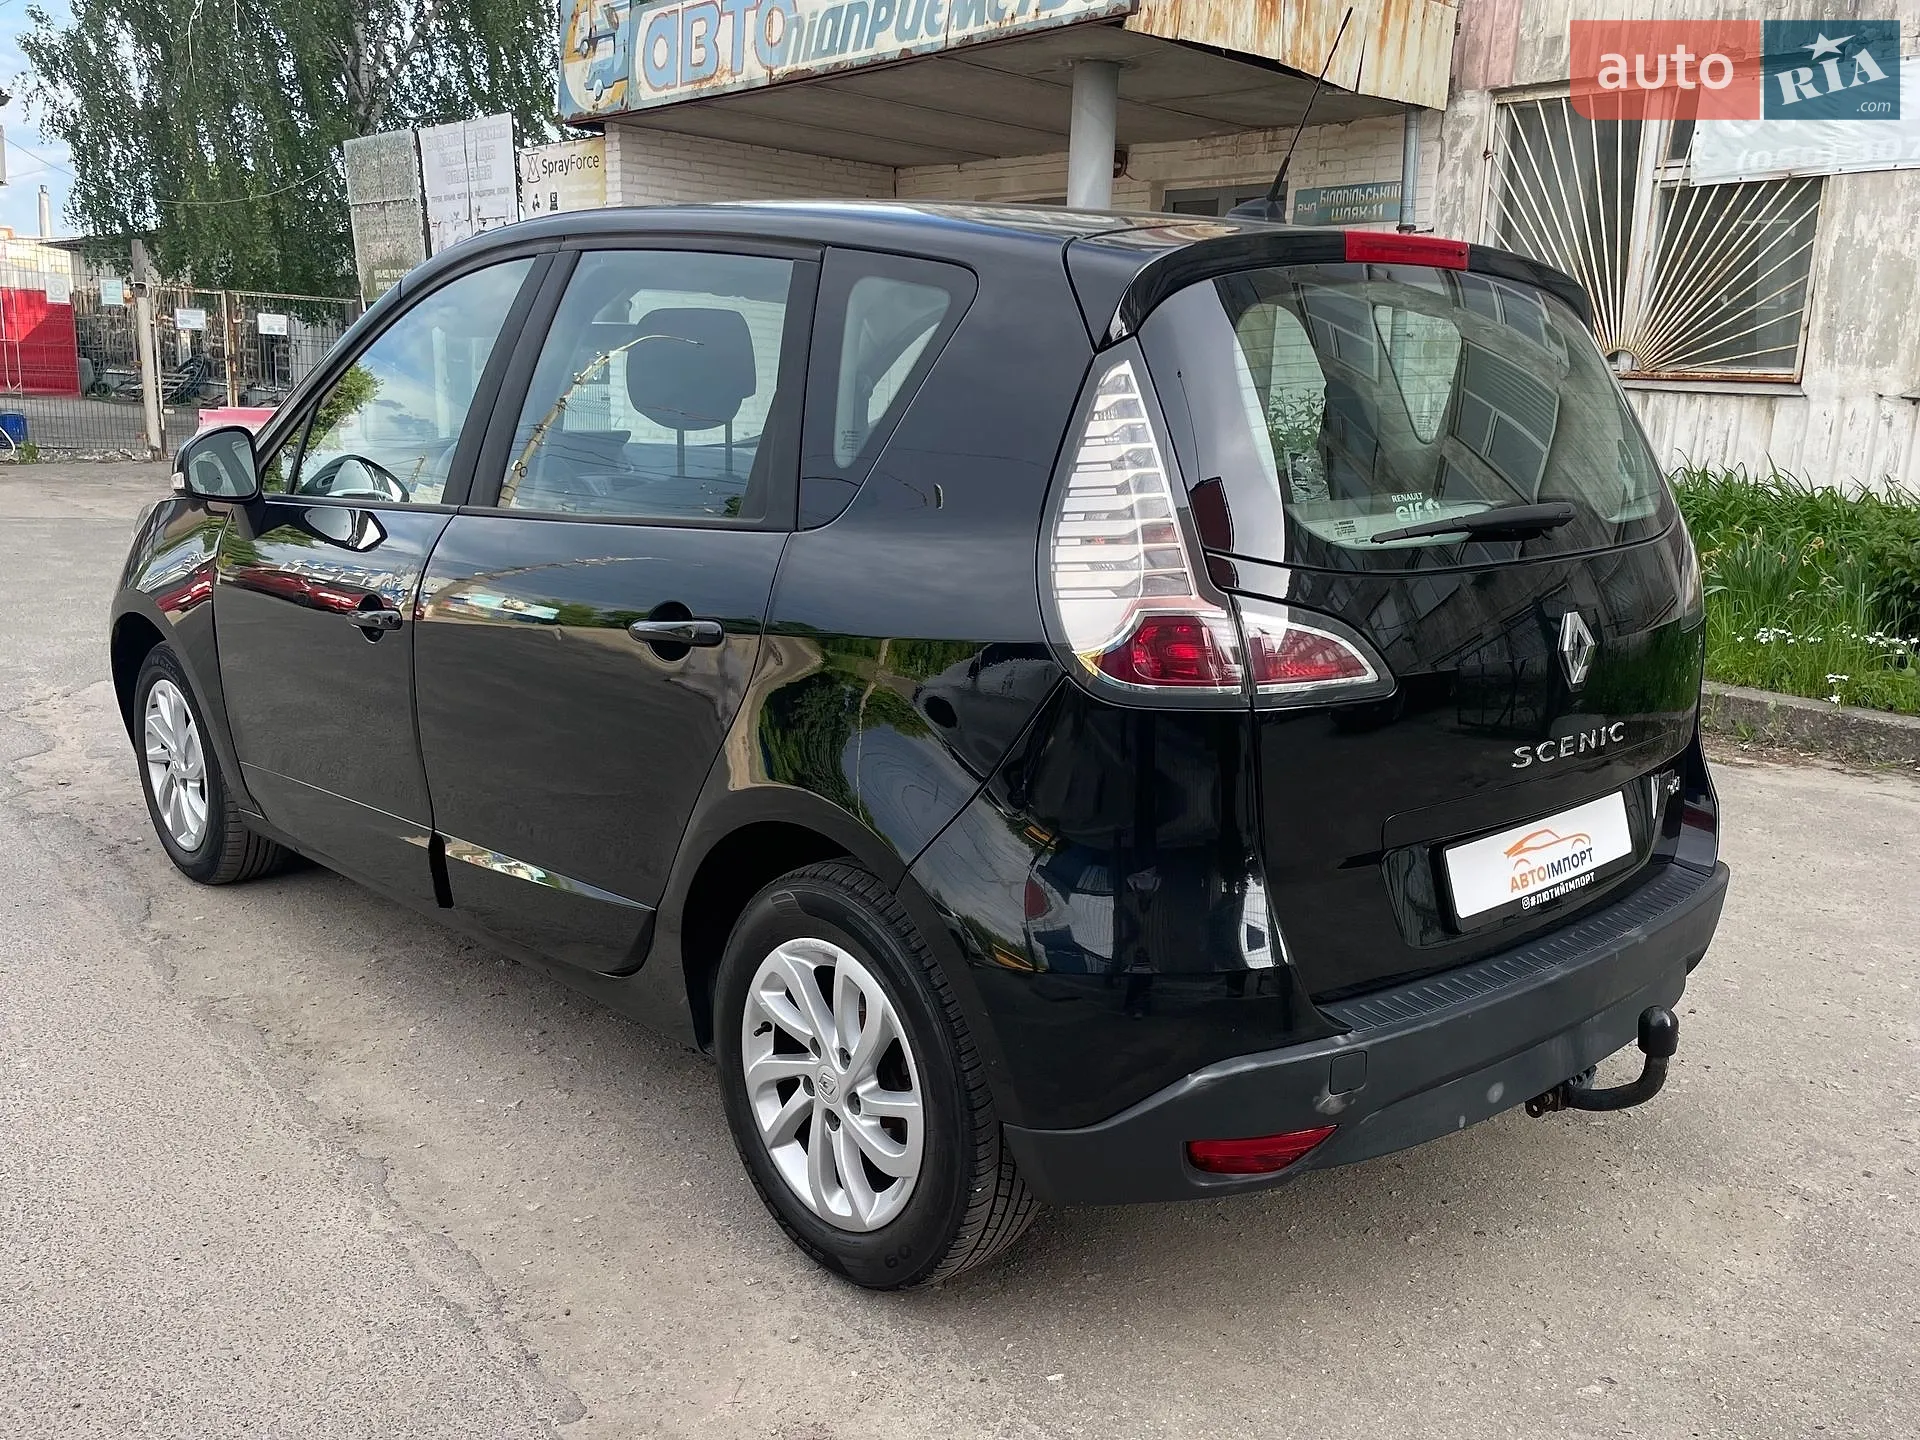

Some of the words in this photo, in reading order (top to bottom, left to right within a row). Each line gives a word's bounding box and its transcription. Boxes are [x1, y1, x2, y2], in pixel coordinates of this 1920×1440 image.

[541, 154, 600, 178] SprayForce
[1391, 492, 1423, 503] RENAULT
[1396, 502, 1422, 521] elf
[1511, 721, 1625, 769] SCENIC
[1511, 847, 1593, 893] АВТОІМПОРТ
